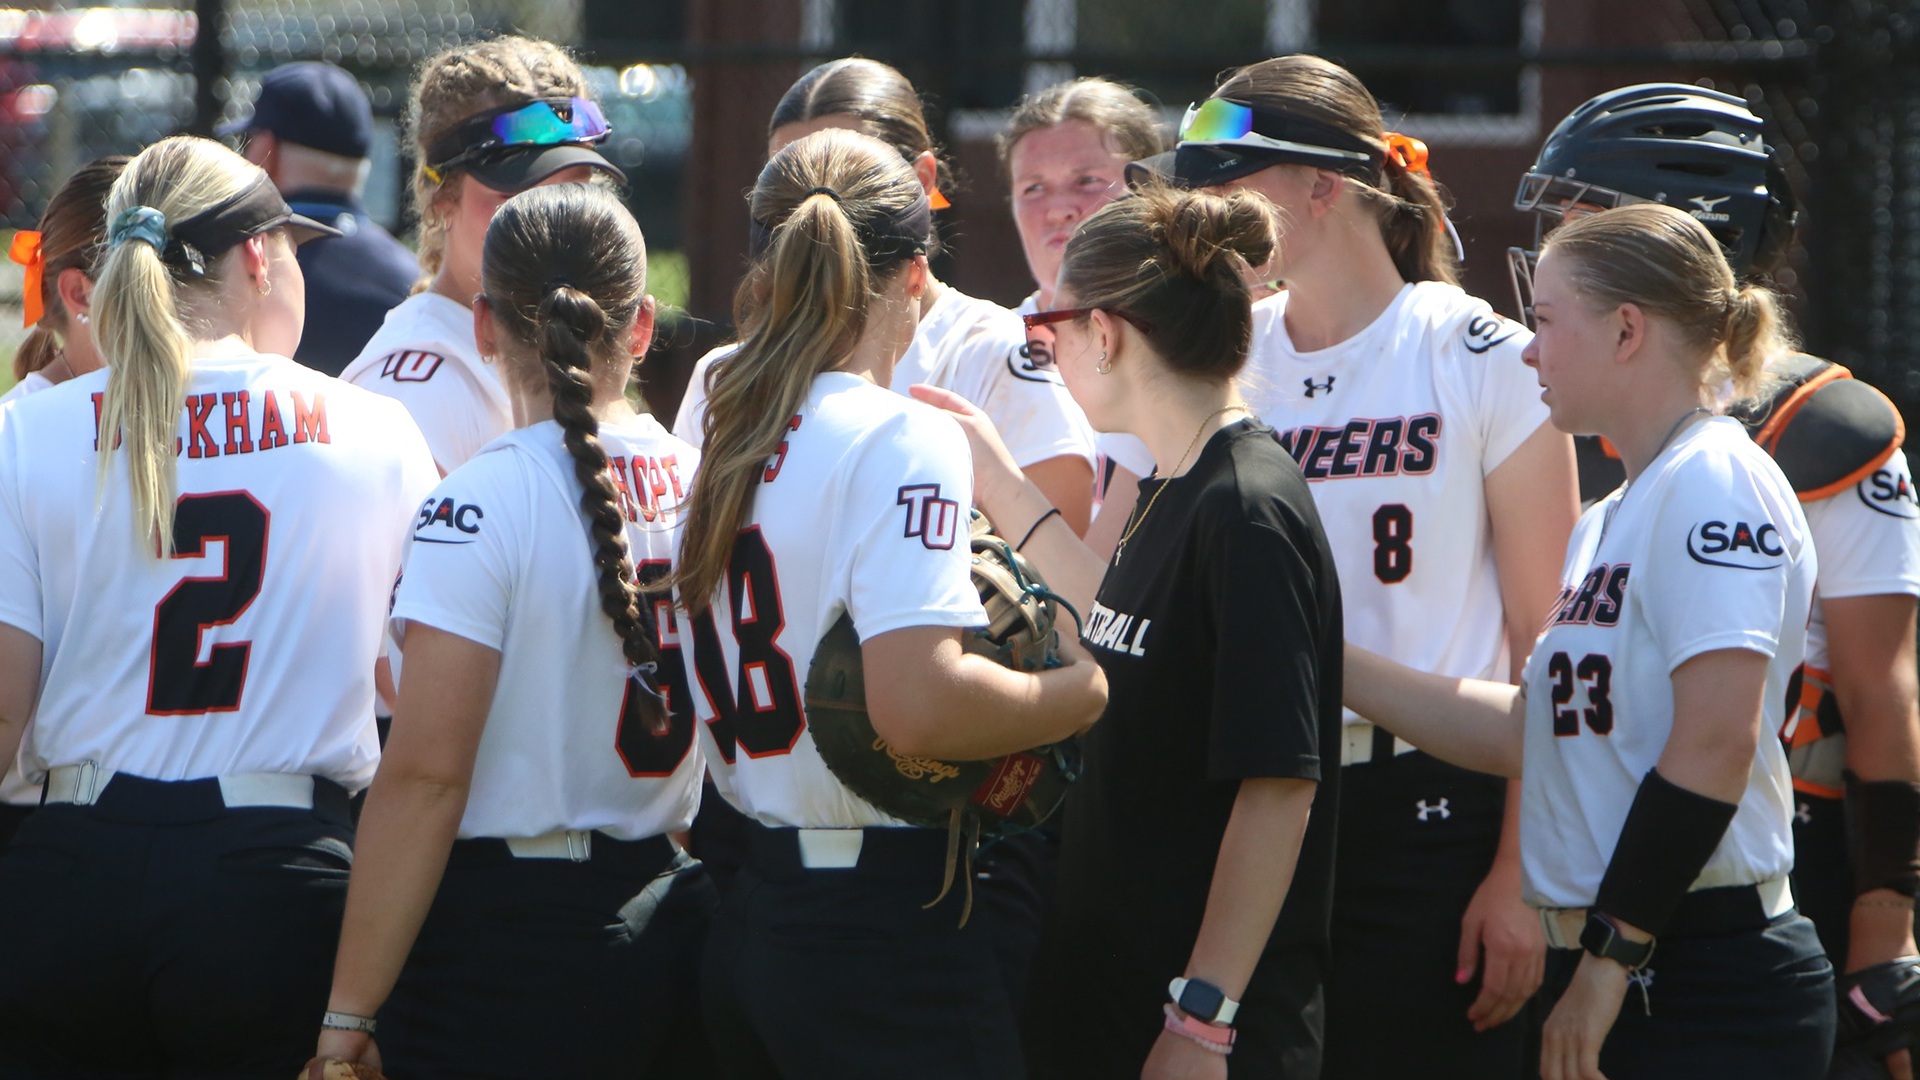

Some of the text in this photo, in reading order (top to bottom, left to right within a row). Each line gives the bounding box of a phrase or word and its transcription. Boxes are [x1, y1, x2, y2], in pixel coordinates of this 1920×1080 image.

[91, 389, 331, 459] KHAM
[1279, 412, 1442, 483] NEERS
[416, 497, 484, 534] SAC
[897, 483, 959, 551] TU
[1373, 503, 1413, 585] 8
[1700, 520, 1784, 557] SAC
[145, 489, 271, 717] 2
[1548, 651, 1614, 737] 23
